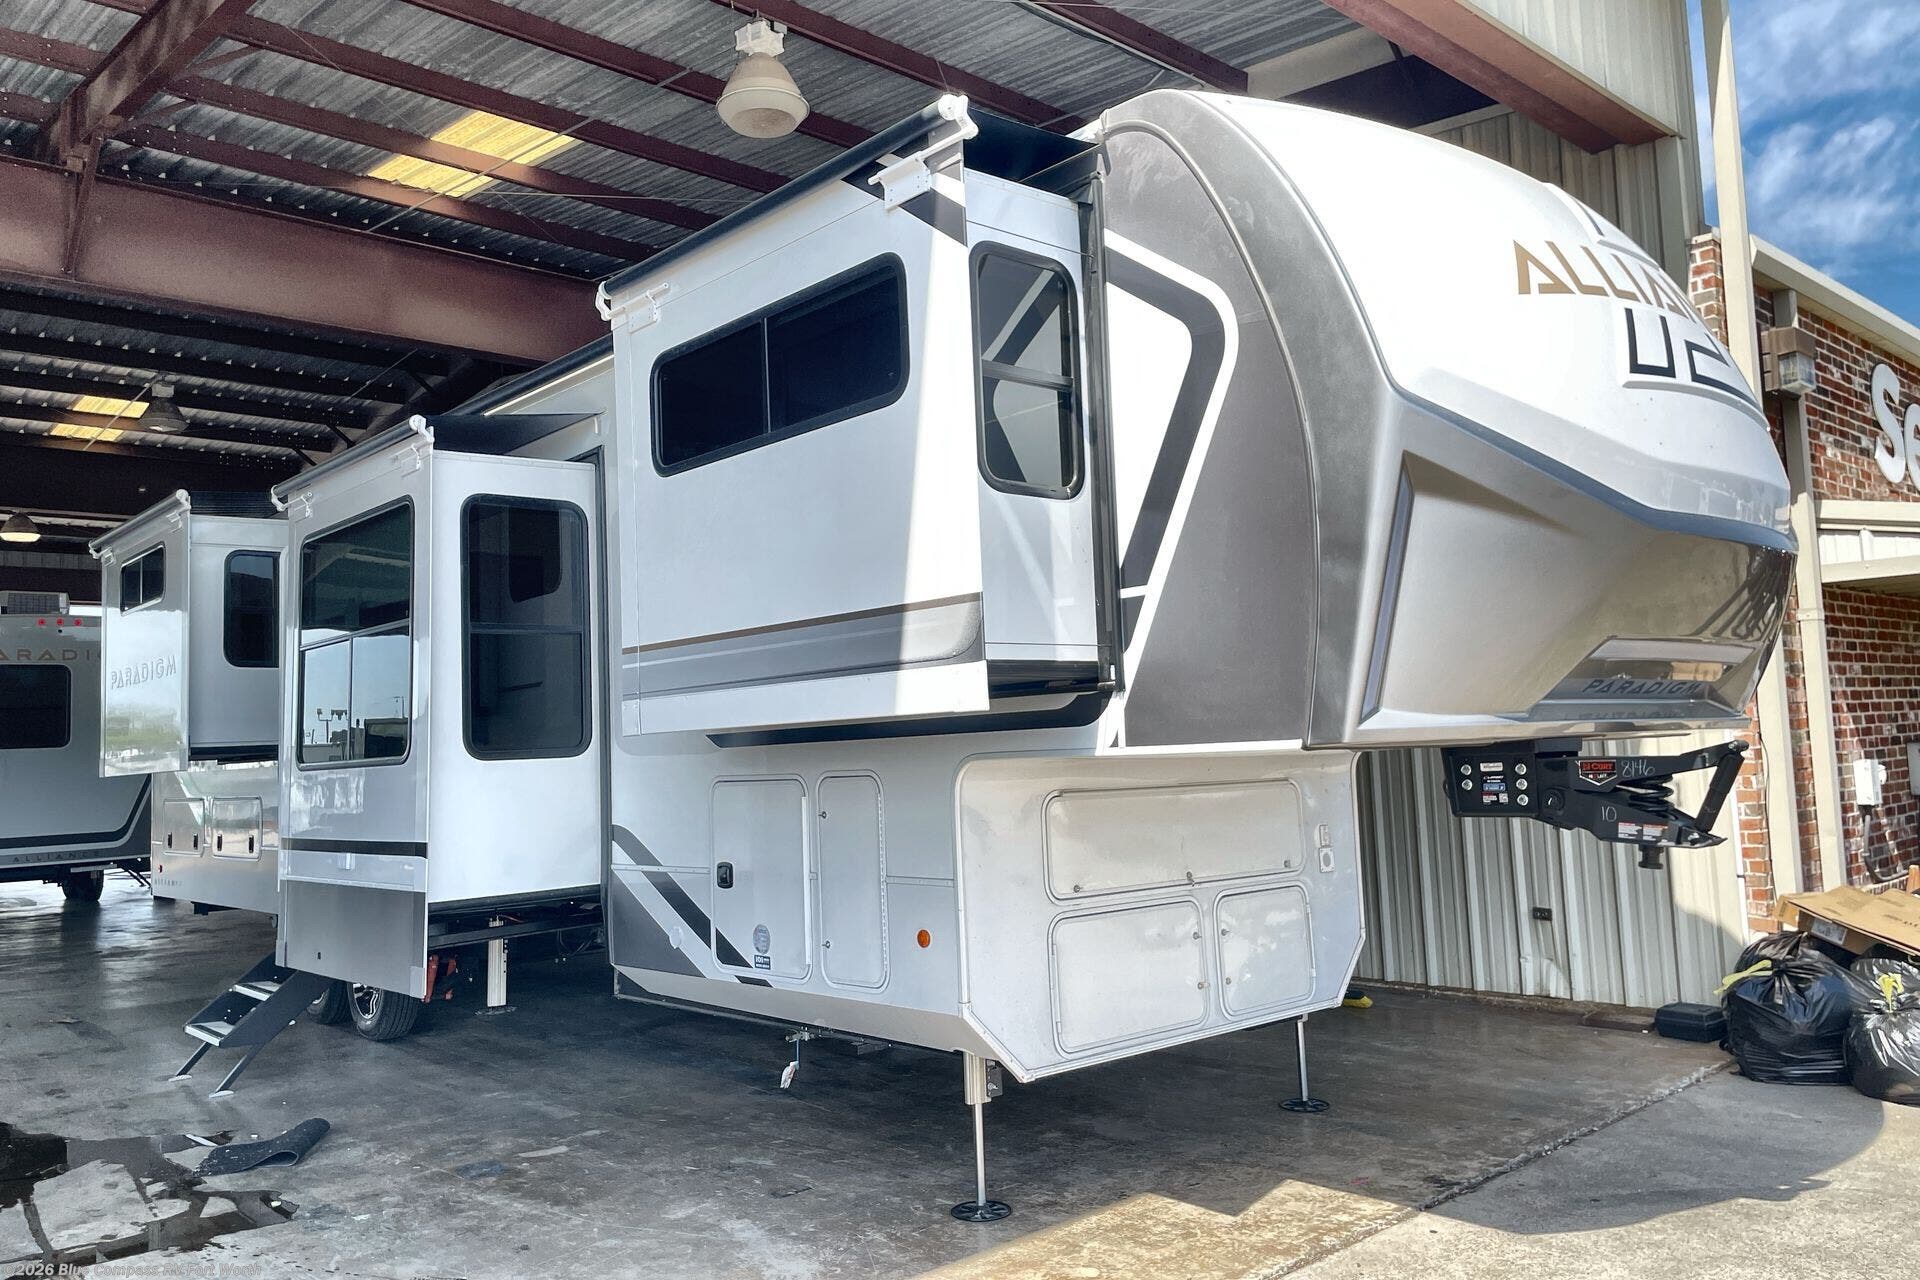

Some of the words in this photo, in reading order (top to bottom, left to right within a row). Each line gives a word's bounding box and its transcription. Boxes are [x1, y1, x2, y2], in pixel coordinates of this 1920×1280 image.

[0, 649, 100, 661] ARADI
[111, 655, 177, 690] PARADIGM
[1583, 679, 1702, 694] PARADIGM
[1601, 806, 1617, 822] 10
